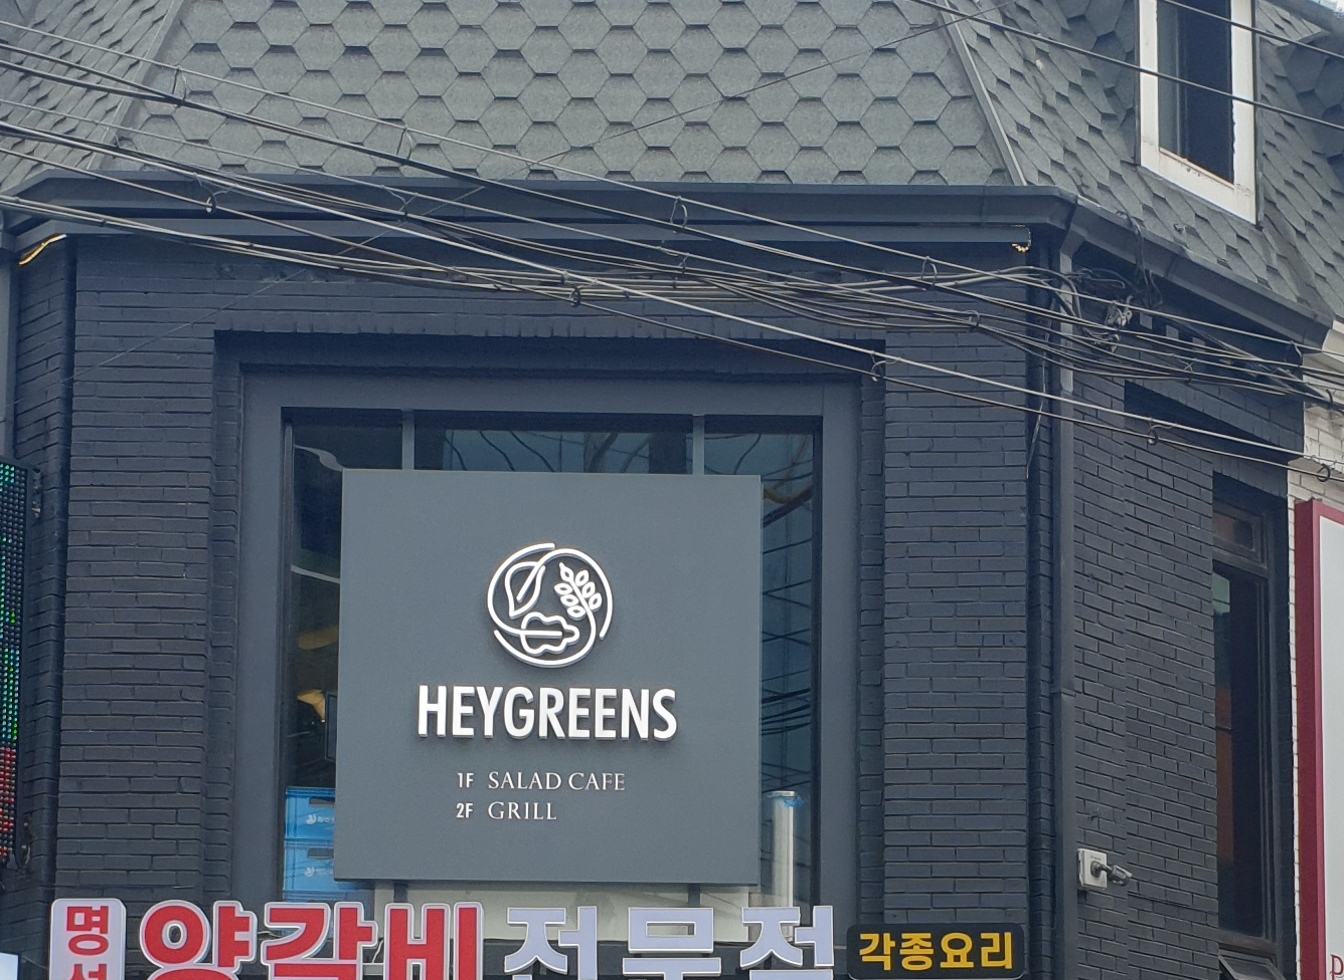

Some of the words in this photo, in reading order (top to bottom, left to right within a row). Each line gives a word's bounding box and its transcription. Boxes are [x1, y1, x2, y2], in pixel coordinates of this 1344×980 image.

[418, 685, 677, 741] HEYGREENS
[457, 772, 474, 789] 1F
[487, 771, 562, 791] SALAD
[567, 772, 626, 791] CAFE
[456, 803, 474, 820] 2F
[487, 801, 557, 821] GRILL
[859, 931, 1014, 971] 각종요리
